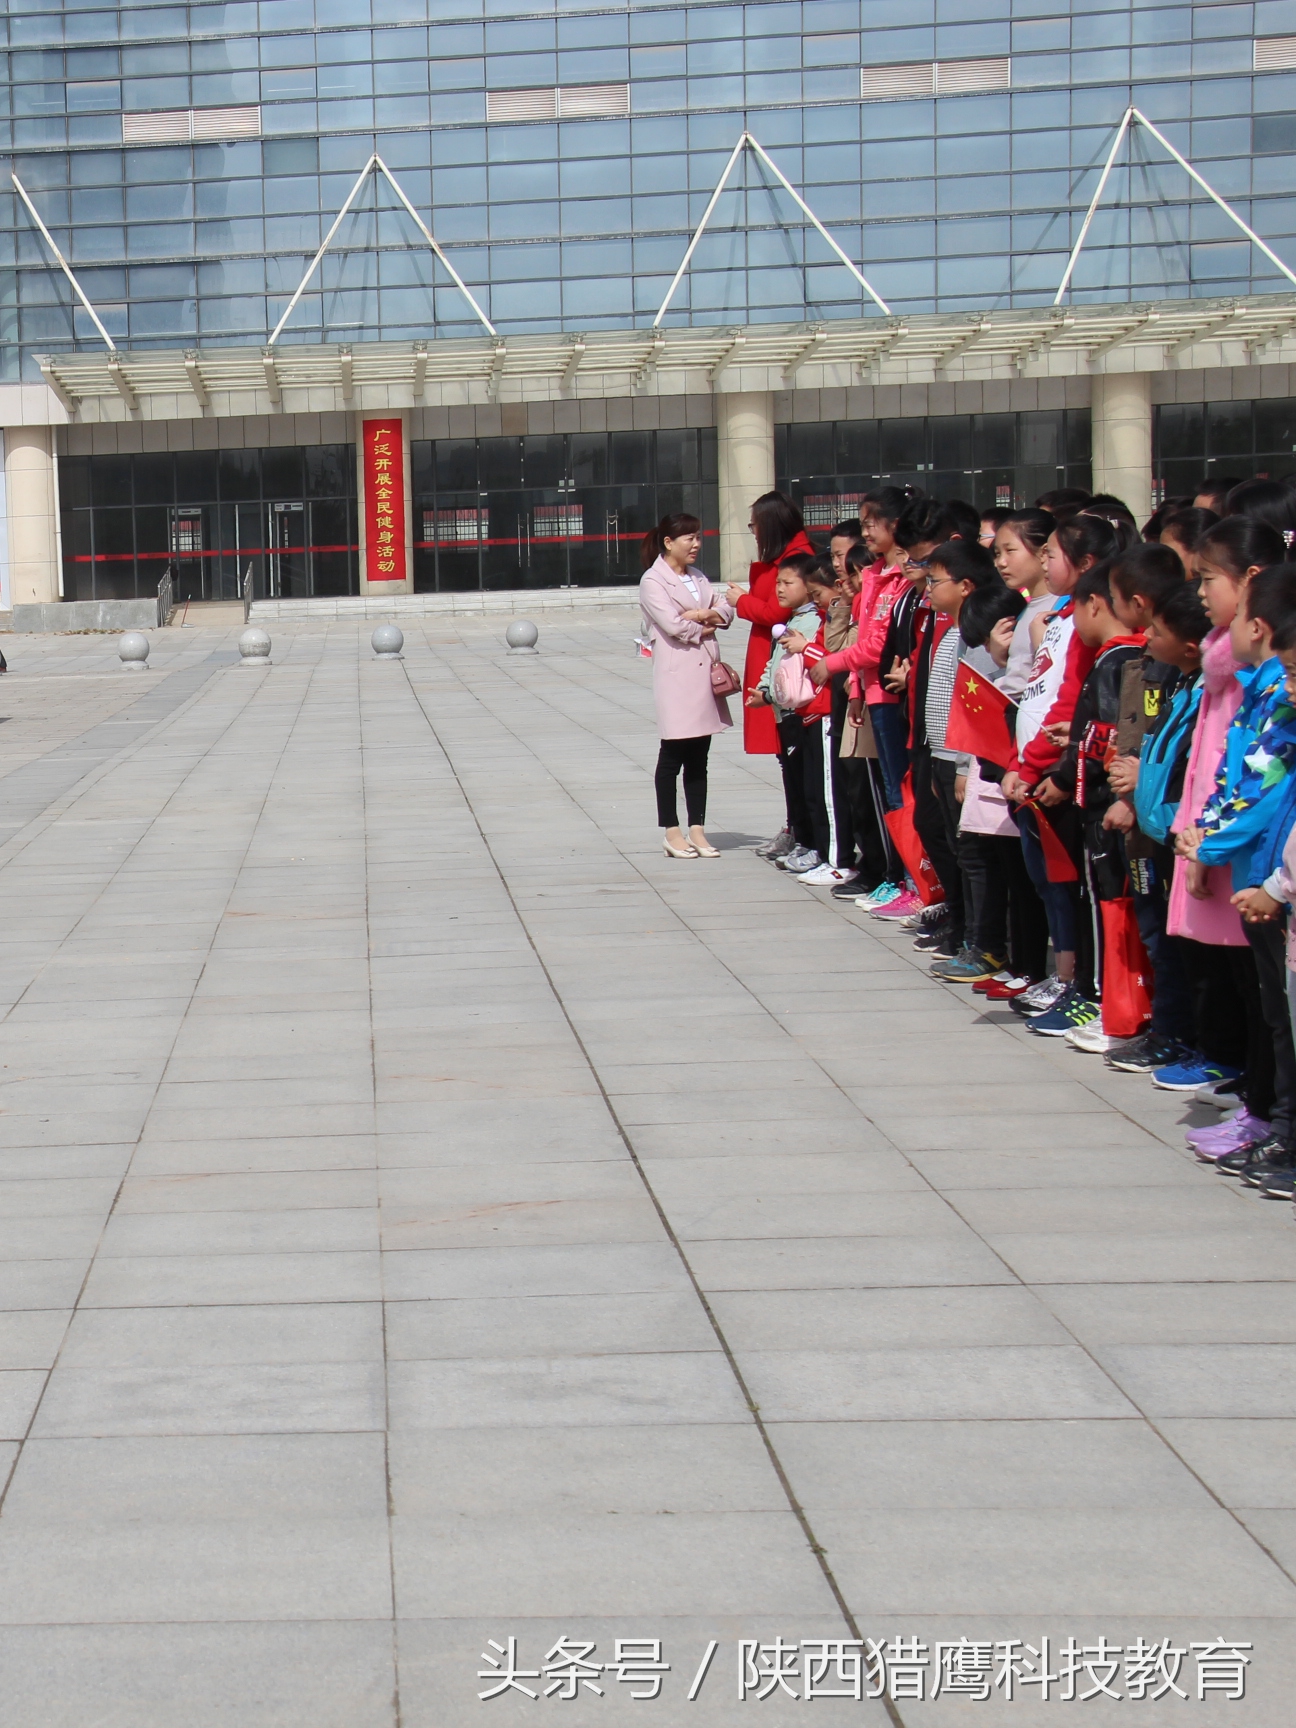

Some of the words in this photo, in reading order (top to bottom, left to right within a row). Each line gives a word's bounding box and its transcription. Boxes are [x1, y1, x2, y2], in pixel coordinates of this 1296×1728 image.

[373, 428, 396, 573] 广泛开展全民健身活动
